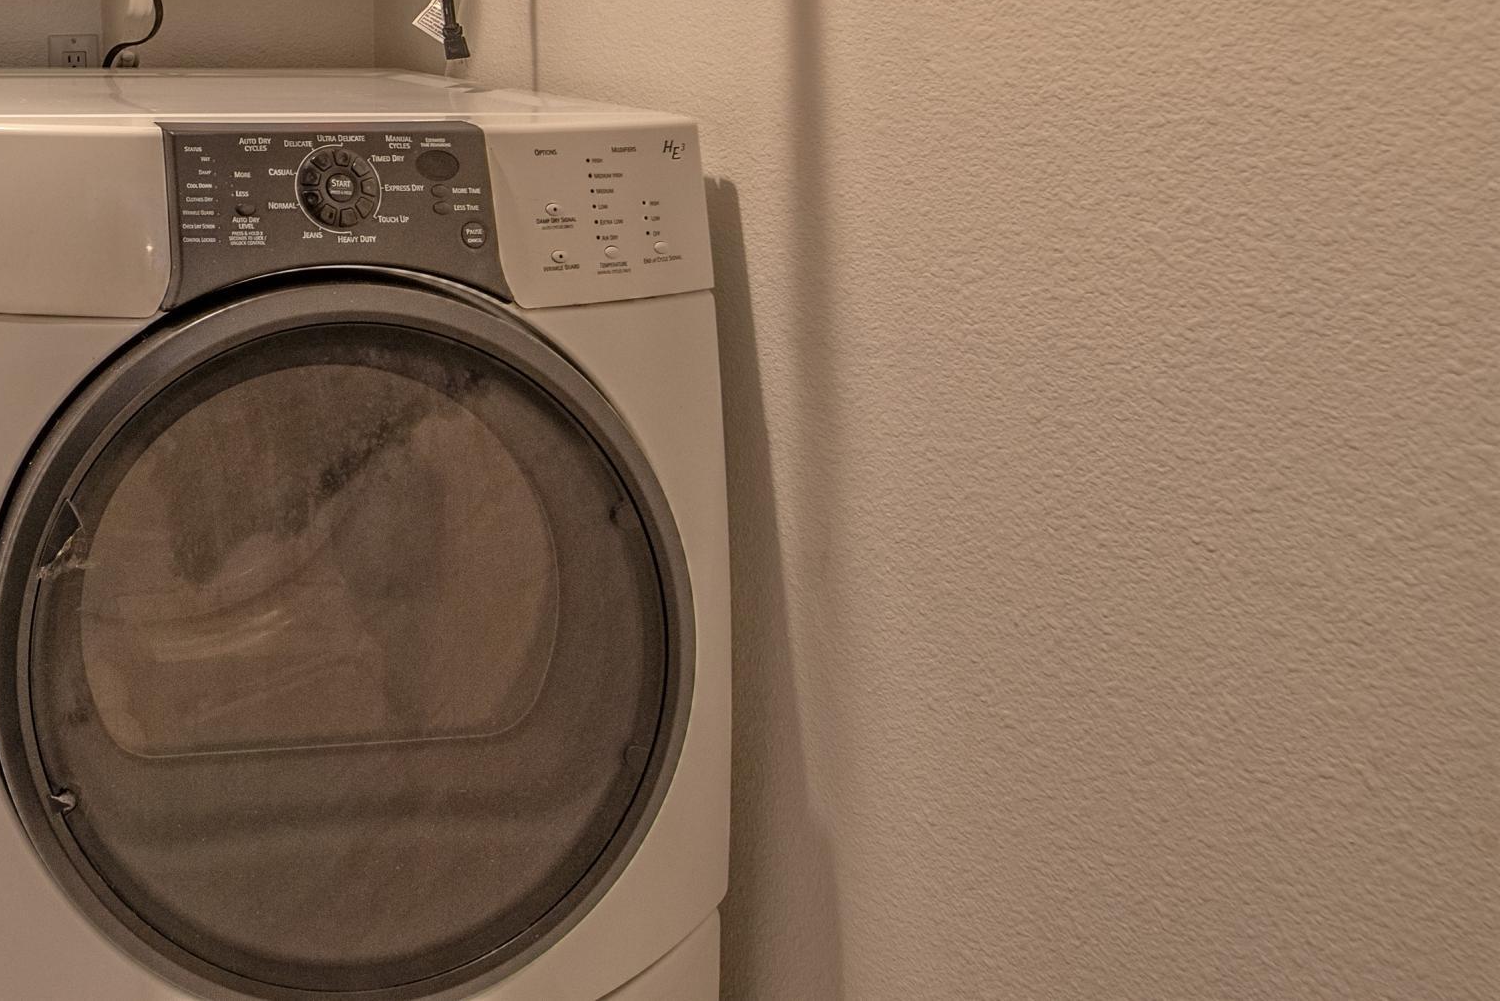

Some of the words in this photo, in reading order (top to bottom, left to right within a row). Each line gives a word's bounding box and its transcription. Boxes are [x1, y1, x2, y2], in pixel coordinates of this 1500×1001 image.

[317, 134, 336, 142] ULTRA
[284, 140, 313, 148] DELICATE
[372, 154, 391, 162] TIMED
[392, 154, 404, 162] DRY
[268, 168, 293, 176] CASUAL
[384, 184, 410, 192] EXPRESS
[412, 184, 424, 192] DRY
[268, 202, 296, 210] NORMAL
[302, 231, 323, 239] JEANS
